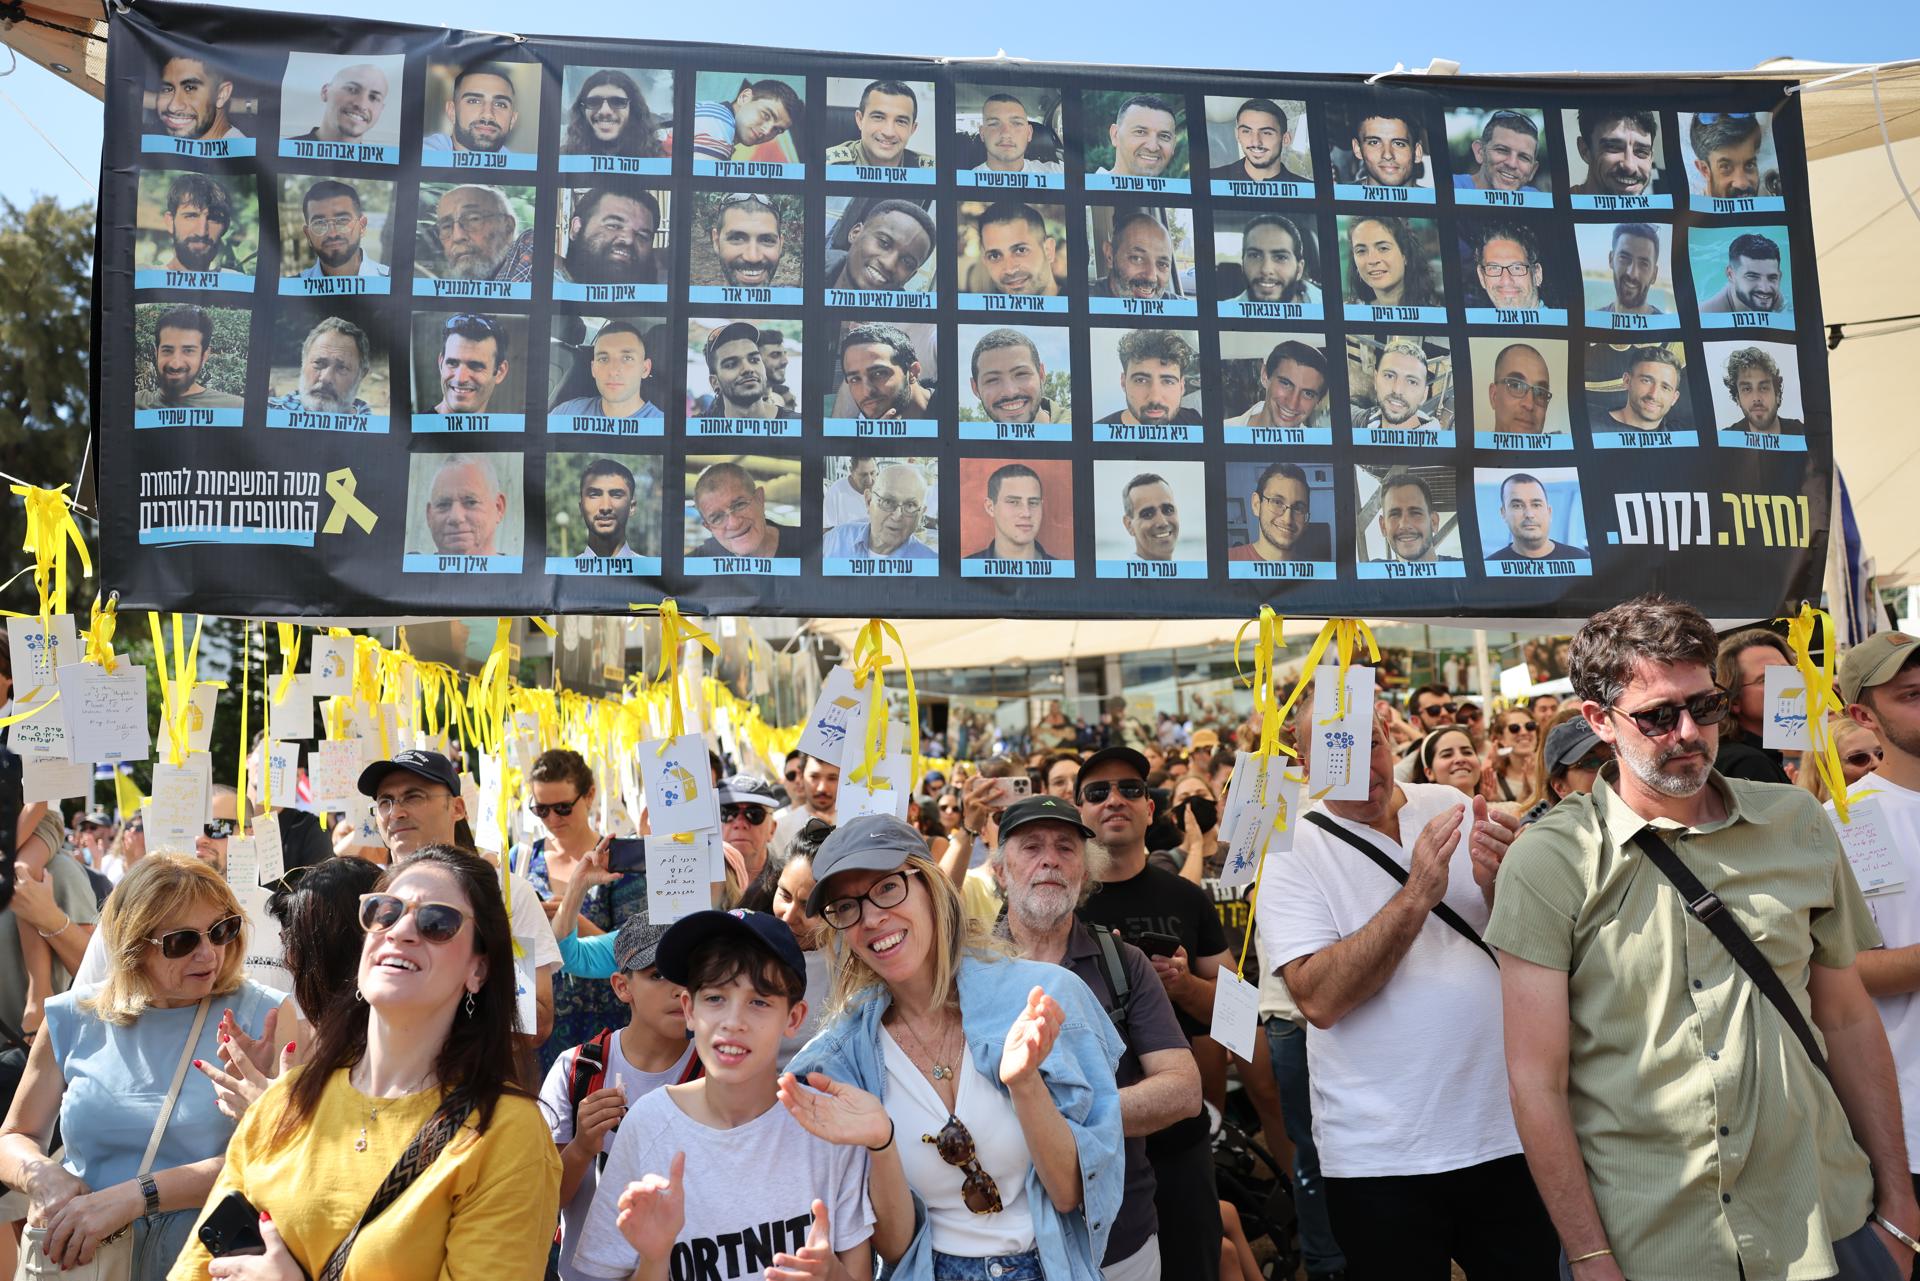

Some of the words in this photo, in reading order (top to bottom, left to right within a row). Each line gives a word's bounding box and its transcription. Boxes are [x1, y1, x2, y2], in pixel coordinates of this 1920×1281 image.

[173, 139, 194, 154] דוד
[197, 141, 230, 157] אביתר
[294, 143, 314, 157] מור
[316, 144, 355, 160] אברהם
[358, 146, 384, 162] איתן
[453, 152, 482, 167] כלפון
[484, 151, 507, 168] שגב
[590, 157, 614, 172] ברוך
[617, 156, 640, 172] סהר
[715, 163, 745, 177] הרקין
[748, 163, 783, 178] מקסים
[855, 167, 882, 181] חממי
[884, 166, 907, 183] אסף
[974, 173, 1029, 188] קופרשטיין
[1034, 175, 1047, 188] בר
[1111, 177, 1144, 190] שרעבי
[1146, 175, 1166, 192] יוסי
[1228, 179, 1279, 196] ברסלבסקי
[1281, 180, 1298, 197] רום
[1362, 184, 1390, 201] דניאל
[1391, 185, 1408, 201] עוז
[1484, 192, 1510, 205] חיימי
[1511, 191, 1524, 206] טל
[1593, 193, 1618, 210] קוניו
[1618, 193, 1650, 209] אריאל
[1712, 198, 1736, 213] קוניו
[1740, 198, 1755, 211] דוד
[166, 272, 197, 287] אילוז
[199, 274, 219, 288] גיא
[303, 278, 335, 294] גואילי
[336, 279, 352, 293] רני
[353, 279, 366, 294] רן
[433, 280, 482, 296] זלמנוביץ
[484, 283, 511, 297] אריה
[586, 286, 608, 301] הורן
[611, 286, 636, 302] איתן
[721, 288, 742, 302] אדר
[744, 289, 771, 303] תמיר
[830, 291, 856, 306] מולל
[858, 289, 893, 307] לואיטו
[896, 290, 931, 308] ג'ושוע
[982, 293, 1006, 310] ברוך
[1008, 295, 1044, 311] אוריאל
[1122, 299, 1138, 313] לוי
[1140, 301, 1164, 315] איתן
[1238, 301, 1281, 318] צנגאוקר
[1282, 302, 1303, 319] מתן
[1395, 305, 1420, 321] ענבר
[1371, 307, 1394, 321] הימן
[1495, 309, 1519, 323] אנגל
[1520, 311, 1540, 324] רונן
[1611, 314, 1633, 329] ברמן
[1731, 310, 1756, 327] ברמן
[1757, 310, 1769, 326] זיו
[1632, 315, 1648, 329] גלי
[157, 410, 187, 426] שתיוי
[189, 410, 214, 426] עידן
[288, 412, 331, 429] מרגלית
[334, 416, 368, 431] אליהו
[444, 416, 463, 431] אור
[465, 416, 489, 431] דרור
[573, 417, 615, 433] אנגרסט
[618, 420, 639, 435] מתן
[700, 420, 733, 434] אוחנה
[735, 420, 760, 434] חיים
[763, 421, 788, 436] יוסף
[855, 421, 874, 436] כהן
[876, 422, 907, 436] נמרוד
[996, 424, 1008, 440] חן
[1010, 425, 1035, 438] איתי
[1108, 424, 1135, 440] דלאל
[1138, 425, 1168, 441] גלבוע
[1170, 427, 1188, 441] גיא
[1251, 428, 1283, 444] גולדין
[1284, 430, 1305, 443] הדר
[1370, 430, 1405, 445] בוחבוט
[1407, 430, 1439, 446] אלקנה
[1493, 434, 1524, 449] רודאיף
[1525, 435, 1552, 449] ליאור
[1618, 433, 1637, 446] אור
[1637, 430, 1673, 448] אבינתן
[1744, 432, 1761, 448] אהל
[1761, 434, 1780, 449] אלון
[140, 467, 191, 496] להחזרת
[195, 470, 278, 496] המשפחות
[283, 471, 320, 496] מטה
[139, 500, 223, 534] והנעדרים
[229, 501, 318, 533] החטופים
[1606, 492, 1711, 551] נקום.
[1718, 492, 1810, 548] נחזיר.
[438, 557, 461, 571] וייס
[464, 556, 488, 573] אילן
[574, 557, 604, 573] ג'ושי
[605, 559, 634, 575] ביפין
[712, 559, 751, 573] גודארד
[754, 559, 772, 573] מני
[849, 559, 874, 576] קופר
[878, 560, 913, 574] עמירם
[984, 561, 1023, 575] נאוטרה
[1025, 561, 1052, 576] עומר
[1126, 563, 1149, 578] מירן
[1151, 563, 1177, 577] עמרי
[1253, 563, 1287, 577] נמרודי
[1289, 563, 1314, 577] תמיר
[1384, 564, 1406, 579] פרץ
[1407, 562, 1437, 577] דניאל
[1500, 559, 1545, 575] אלאטרש
[1546, 559, 1576, 575] מחמד
